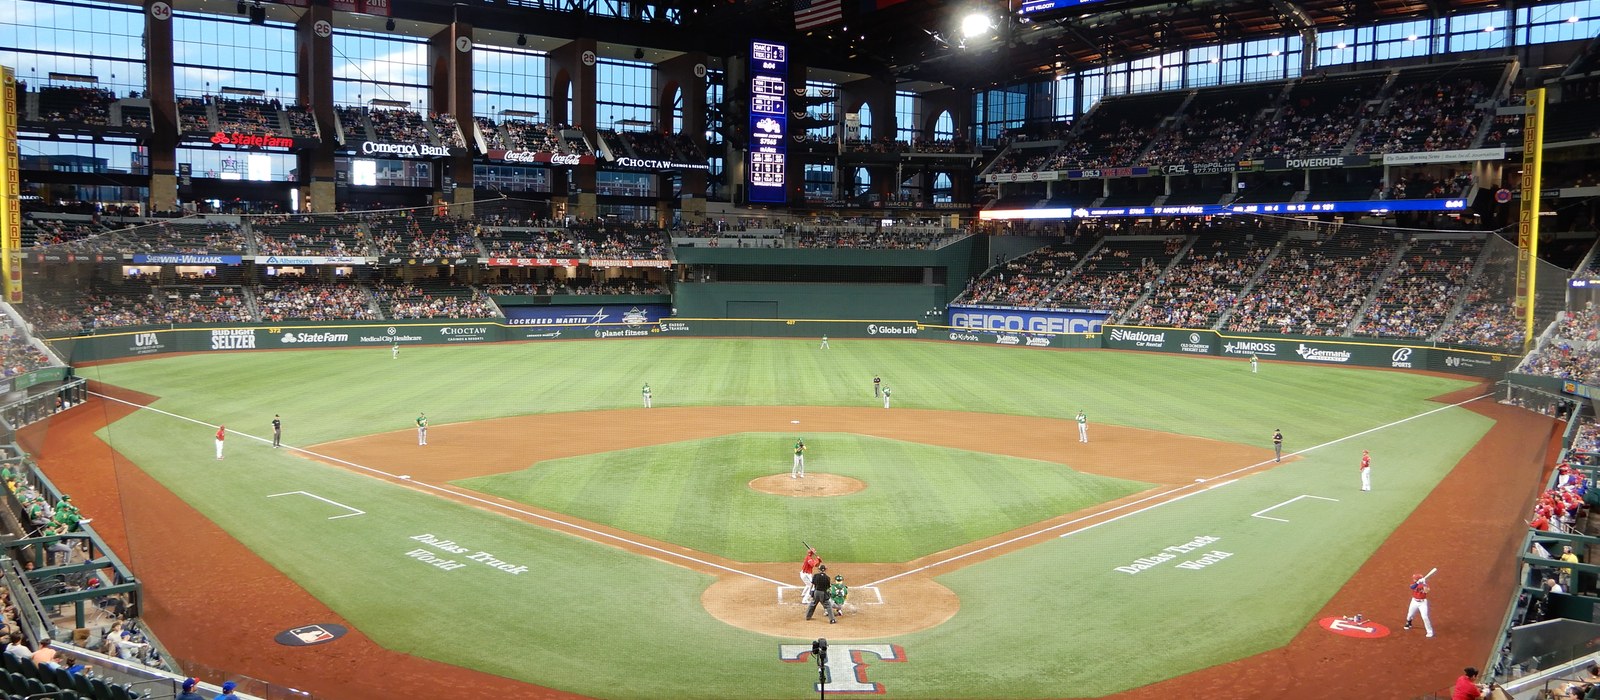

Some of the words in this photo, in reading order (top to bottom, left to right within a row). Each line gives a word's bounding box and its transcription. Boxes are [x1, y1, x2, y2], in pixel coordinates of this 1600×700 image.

[155, 6, 169, 17] 34
[315, 23, 331, 34] 26
[460, 40, 468, 49] 7
[584, 53, 596, 64] 29
[695, 65, 706, 76] 10
[5, 87, 17, 153] BRING
[1525, 115, 1536, 154] THE
[421, 145, 450, 157] Bank
[622, 157, 671, 169] CHOCTAW
[1169, 165, 1189, 173] PGL
[1285, 157, 1344, 168] POWERADE
[8, 156, 19, 195] THE
[1081, 170, 1100, 178] 105.3
[1523, 163, 1533, 200] HOT
[9, 199, 19, 251] HEAT
[1519, 210, 1530, 261] ZONE
[878, 326, 902, 334] Globe
[903, 326, 918, 334] Life
[952, 312, 1024, 336] GEICO
[135, 332, 159, 347] UTA
[602, 329, 624, 338] planet
[211, 335, 256, 350] SELTZER
[1312, 349, 1351, 358] Germania
[405, 548, 467, 571] World
[409, 533, 470, 554] Dallas
[466, 551, 529, 575] Truck
[1113, 552, 1177, 575] Dallas
[1162, 535, 1221, 554] Truck
[1174, 550, 1235, 570] World
[778, 643, 908, 695] T
